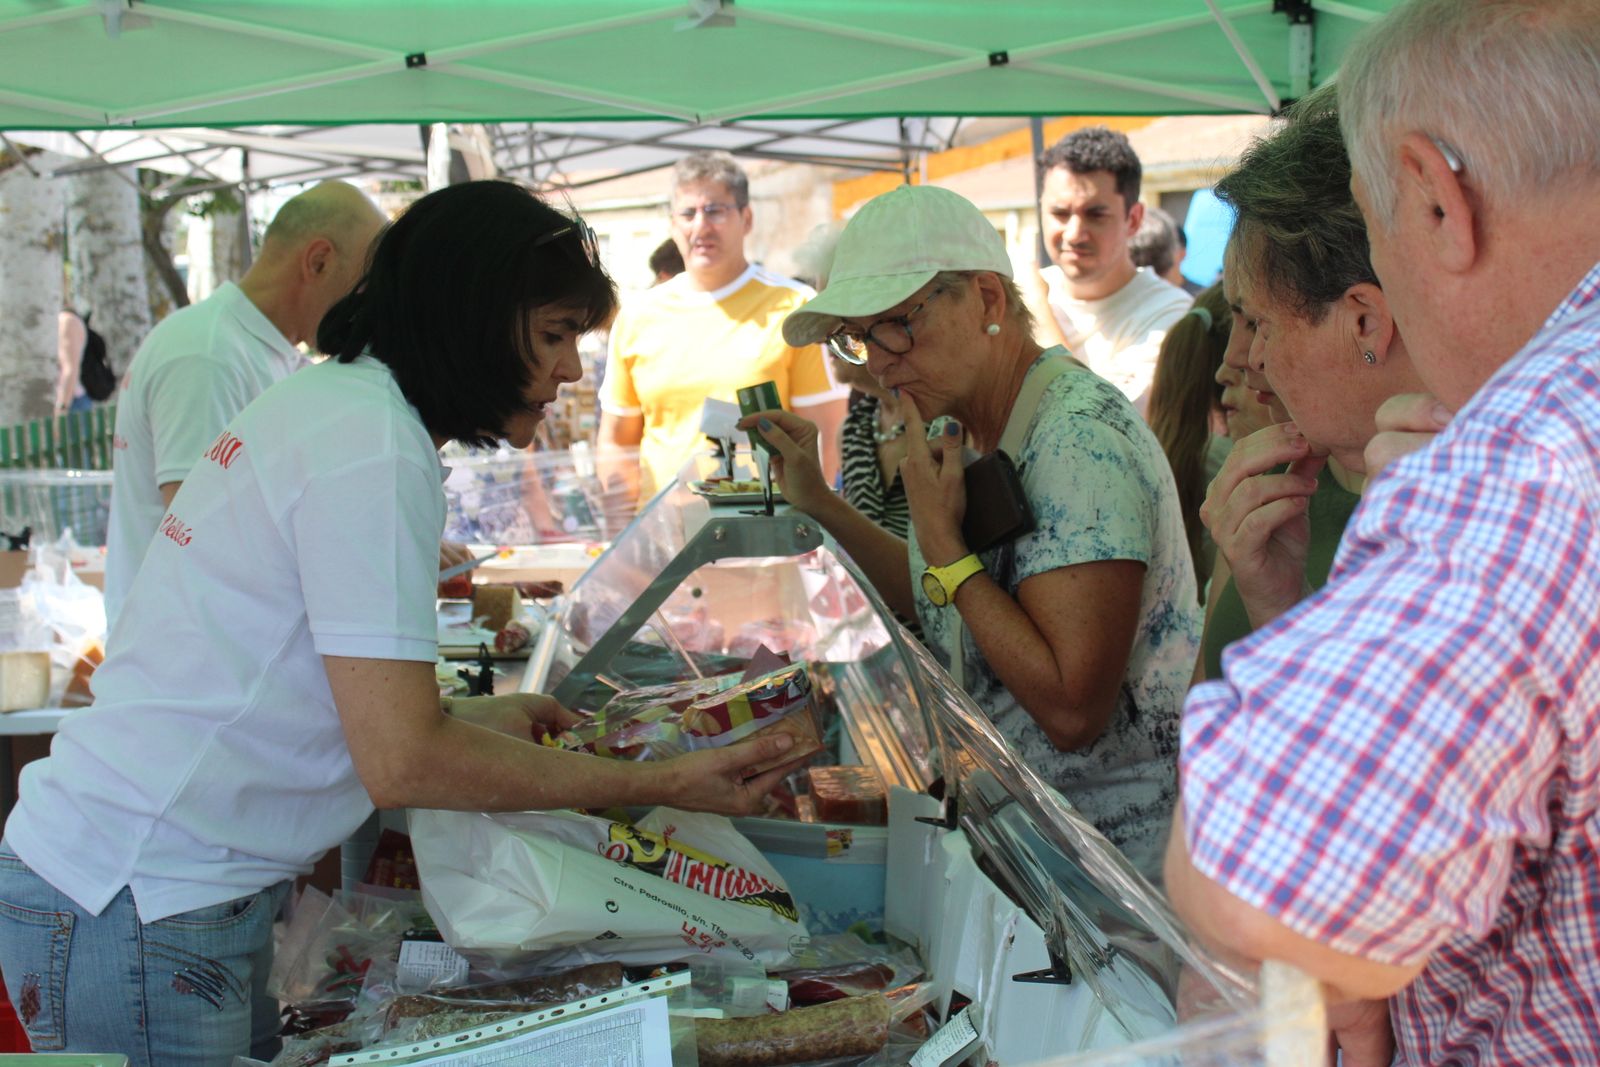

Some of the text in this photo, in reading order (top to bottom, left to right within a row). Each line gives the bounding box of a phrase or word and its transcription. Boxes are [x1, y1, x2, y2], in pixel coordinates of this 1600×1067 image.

[613, 876, 638, 893] Ctra.
[639, 887, 690, 919] Pedrosillo,
[691, 913, 709, 928] s/n.
[681, 920, 698, 938] LA
